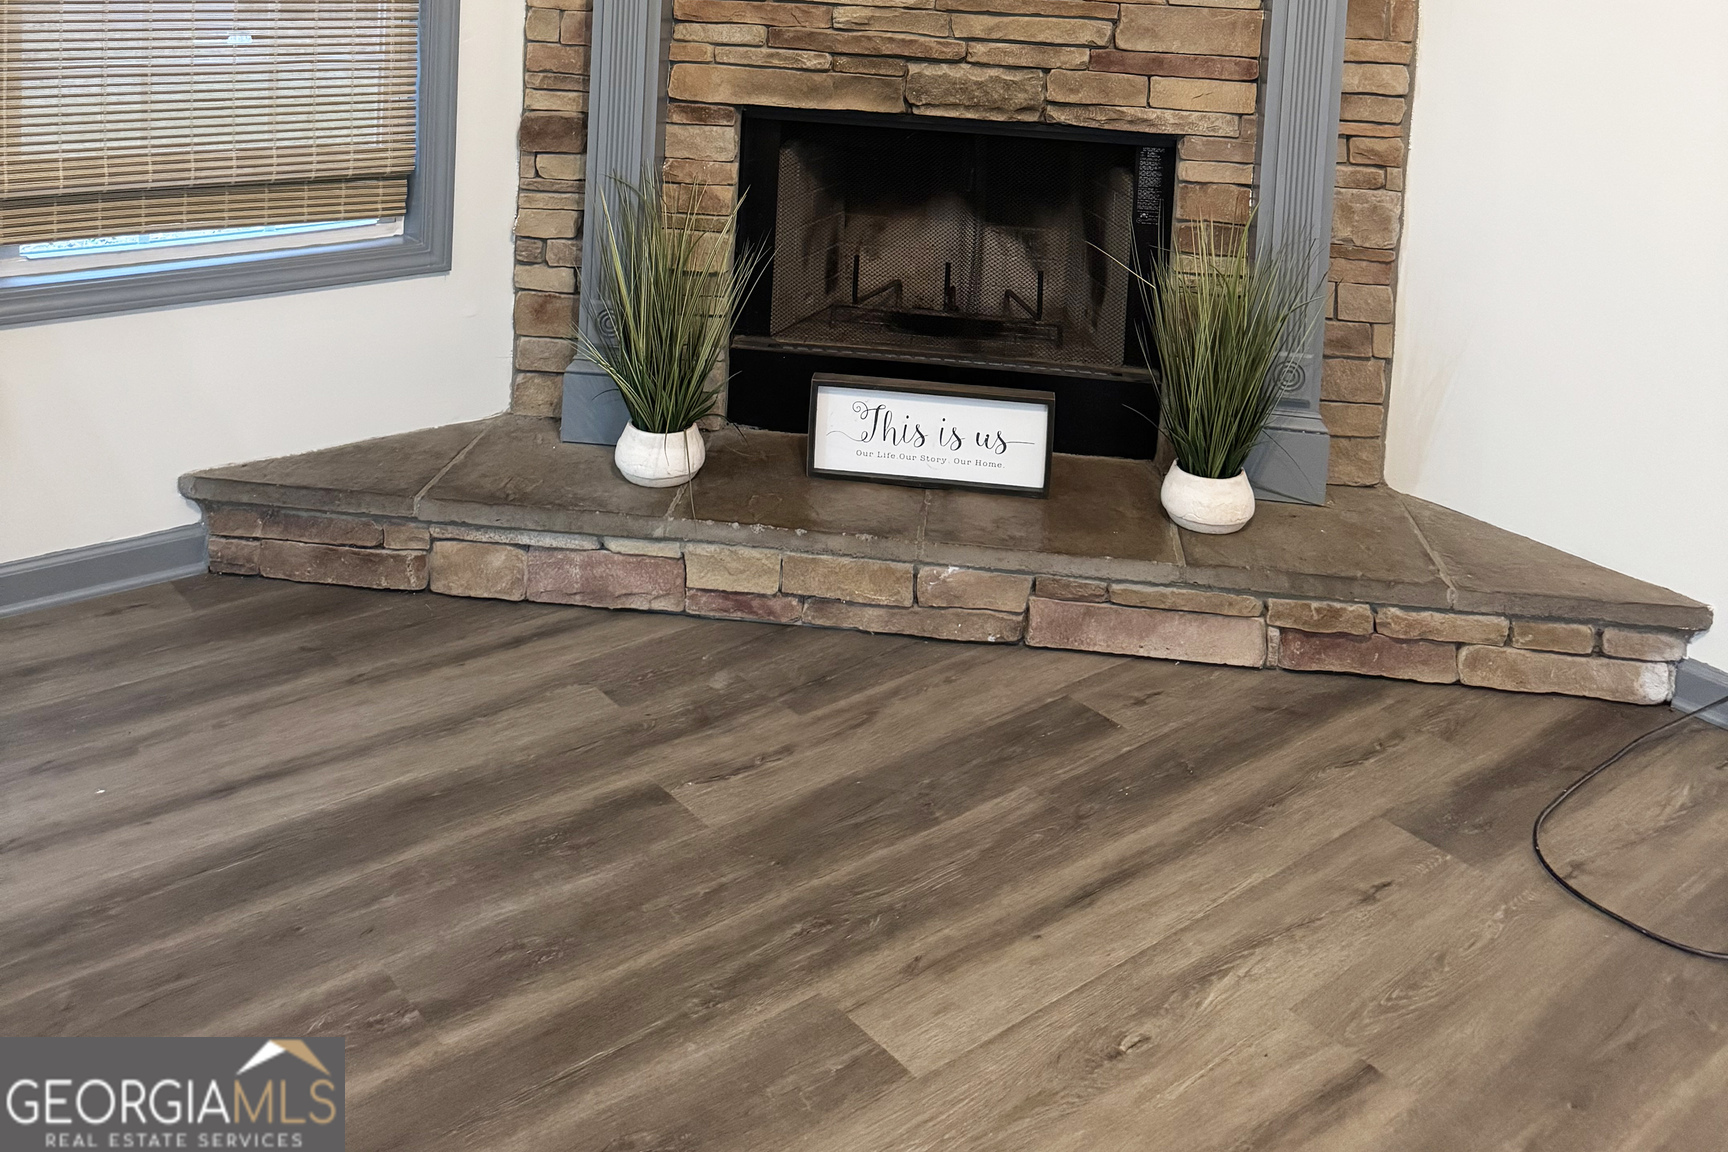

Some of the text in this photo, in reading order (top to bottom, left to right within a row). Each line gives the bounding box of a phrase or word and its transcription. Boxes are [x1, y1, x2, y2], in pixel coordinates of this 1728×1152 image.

[826, 400, 1035, 455] This is us
[855, 449, 874, 458] Our
[899, 453, 917, 461] Our
[953, 457, 972, 466] Our
[975, 459, 1006, 469] Home.
